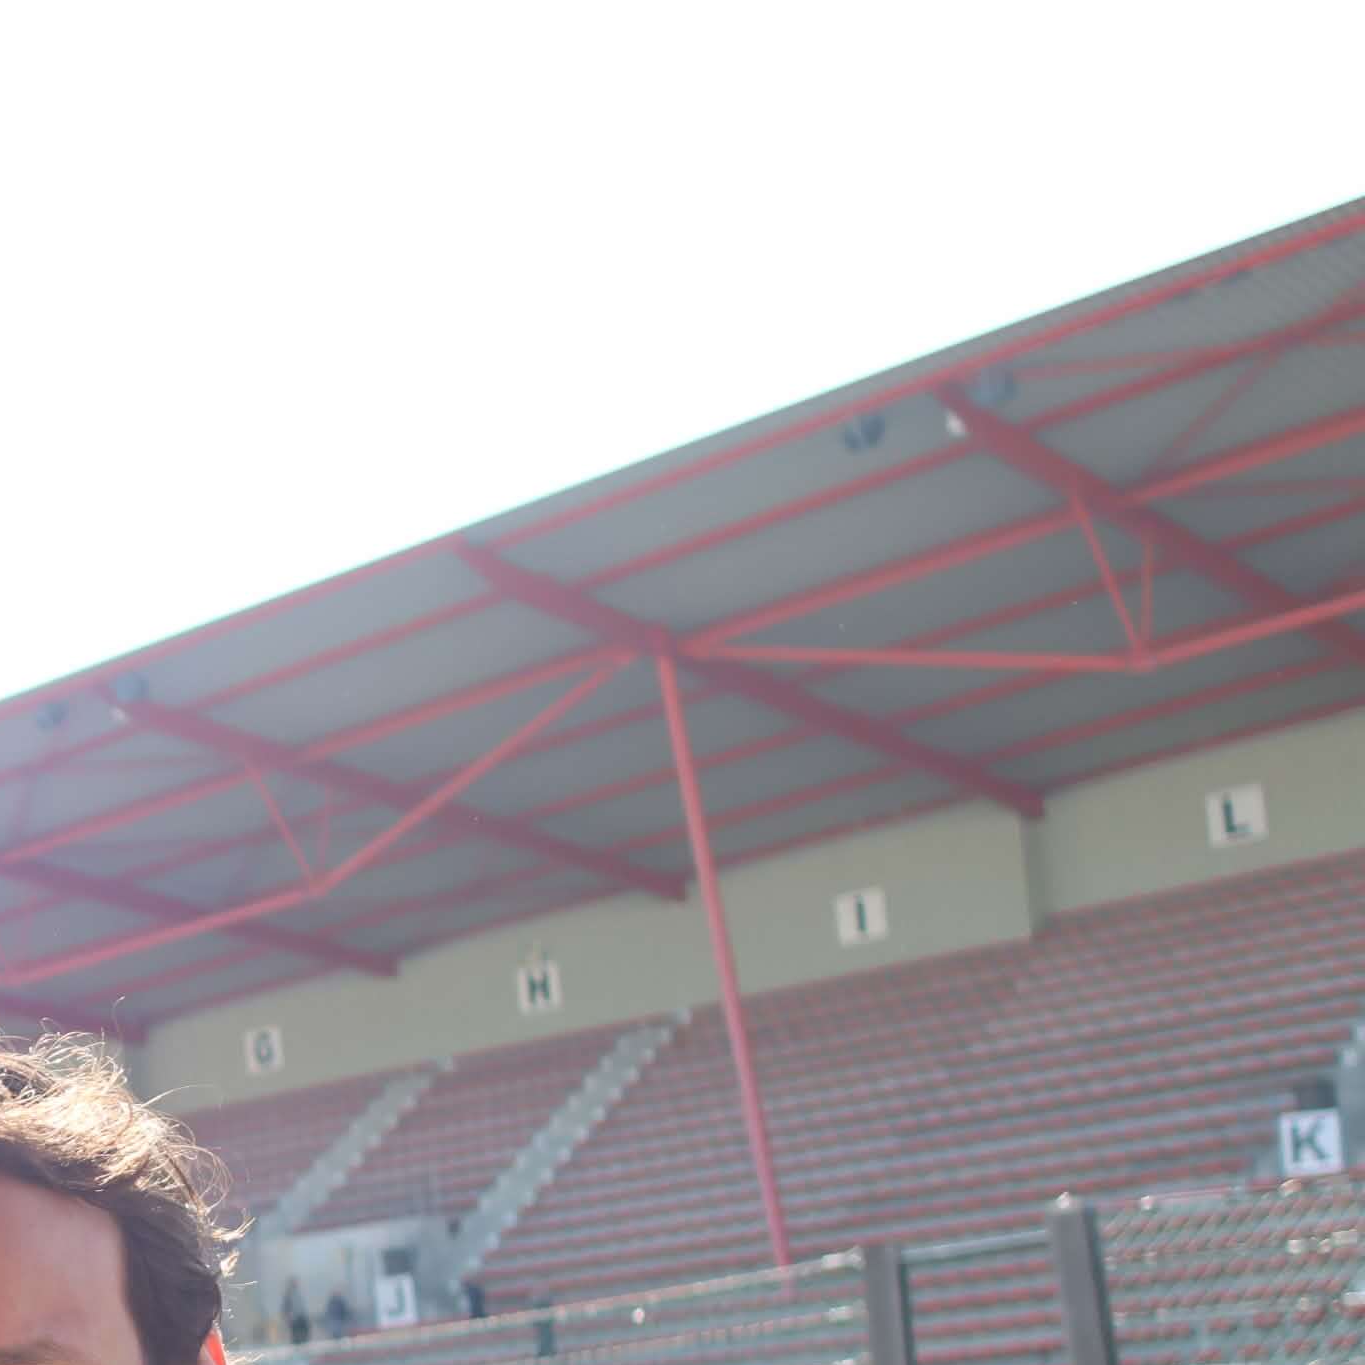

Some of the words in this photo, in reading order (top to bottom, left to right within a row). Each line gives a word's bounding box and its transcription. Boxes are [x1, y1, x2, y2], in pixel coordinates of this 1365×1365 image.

[1223, 796, 1253, 837] L
[854, 896, 868, 934] I
[528, 970, 550, 1005] H
[1291, 1119, 1333, 1162] K
